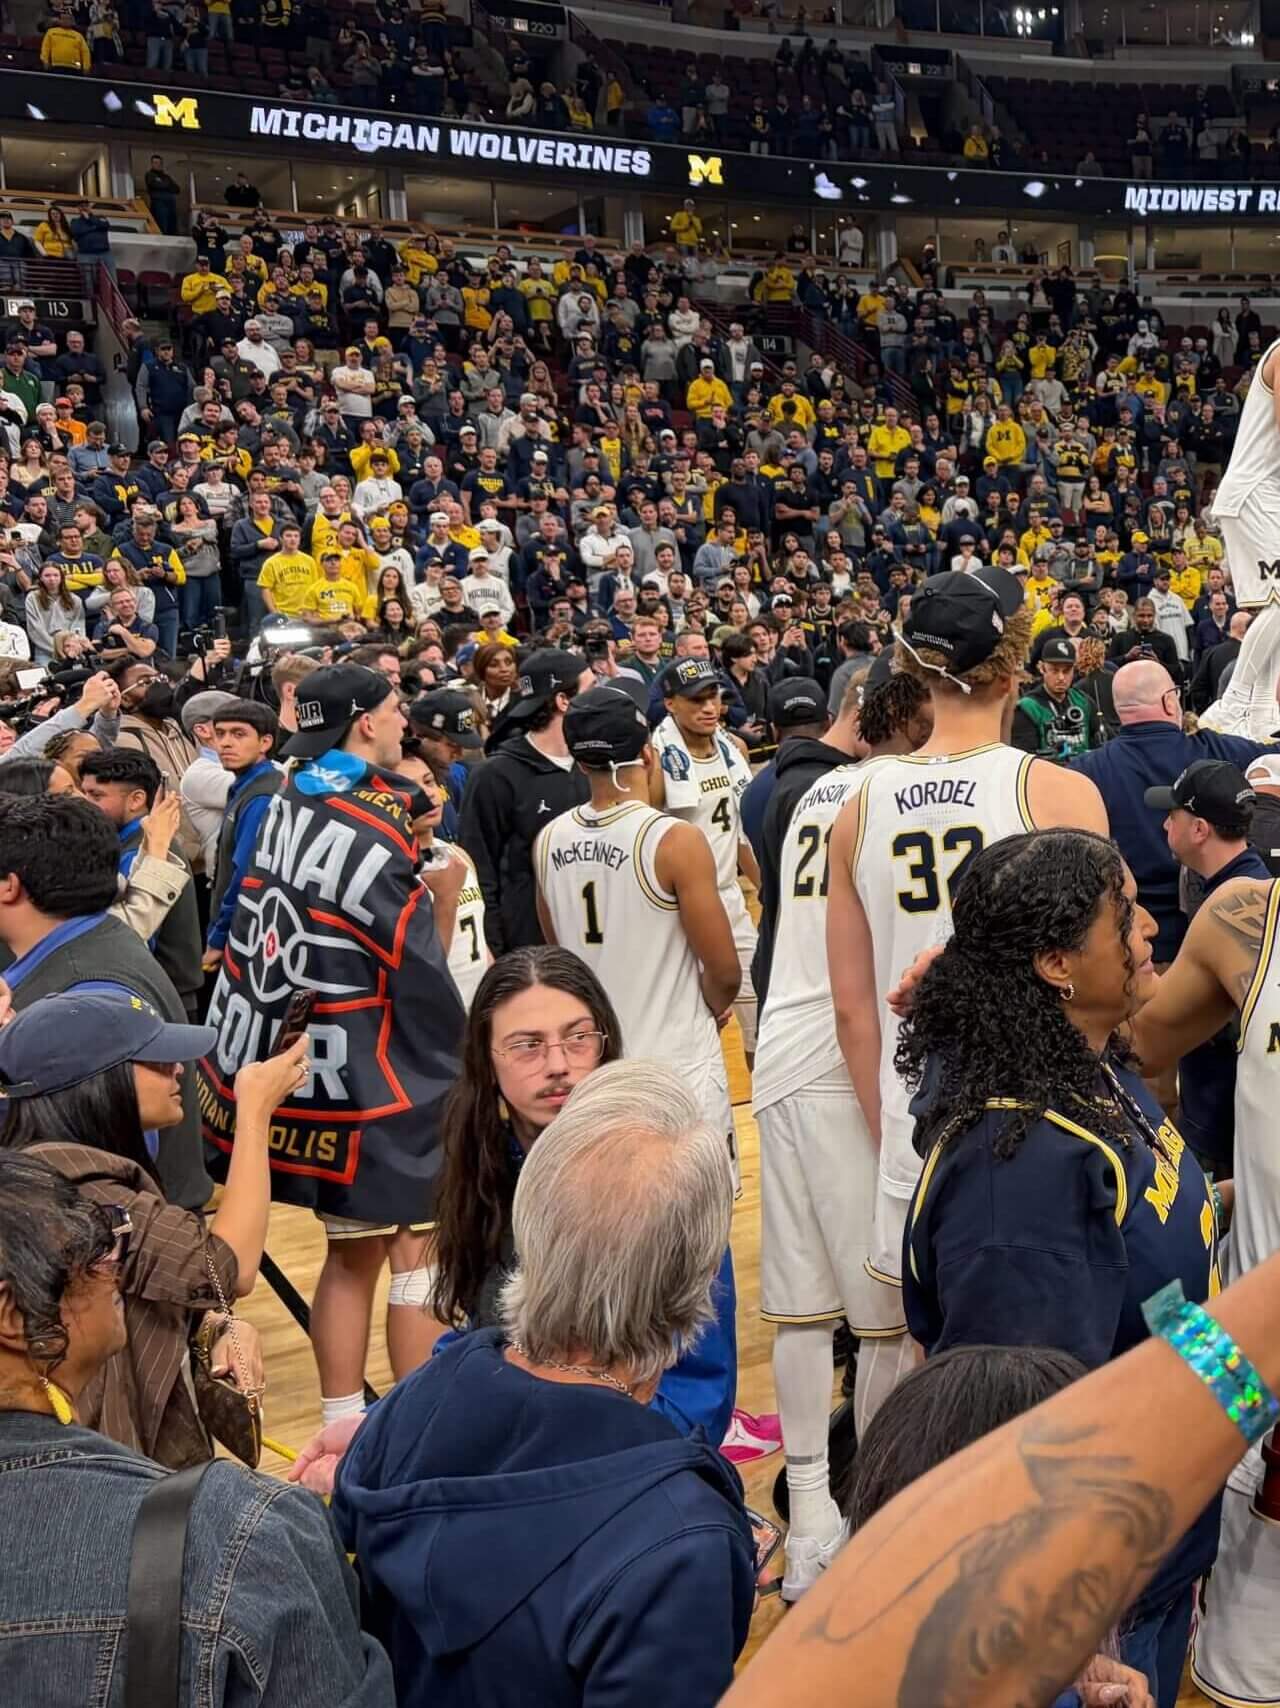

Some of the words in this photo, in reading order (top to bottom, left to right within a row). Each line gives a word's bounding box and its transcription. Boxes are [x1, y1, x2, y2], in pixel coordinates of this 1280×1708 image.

[153, 94, 199, 129] M
[250, 106, 440, 153] MICHIGAN
[450, 130, 652, 176] WOLVERINES
[688, 154, 724, 186] M
[1124, 187, 1253, 216] MIDWEST
[48, 302, 69, 317] 113
[762, 338, 777, 350] 114
[700, 775, 731, 794] CHIG
[894, 779, 978, 815] KORDEL
[710, 797, 732, 833] 4
[256, 793, 392, 926] INAL
[551, 841, 630, 872] McKENNEY
[581, 880, 604, 945] 1
[460, 914, 482, 962] 7
